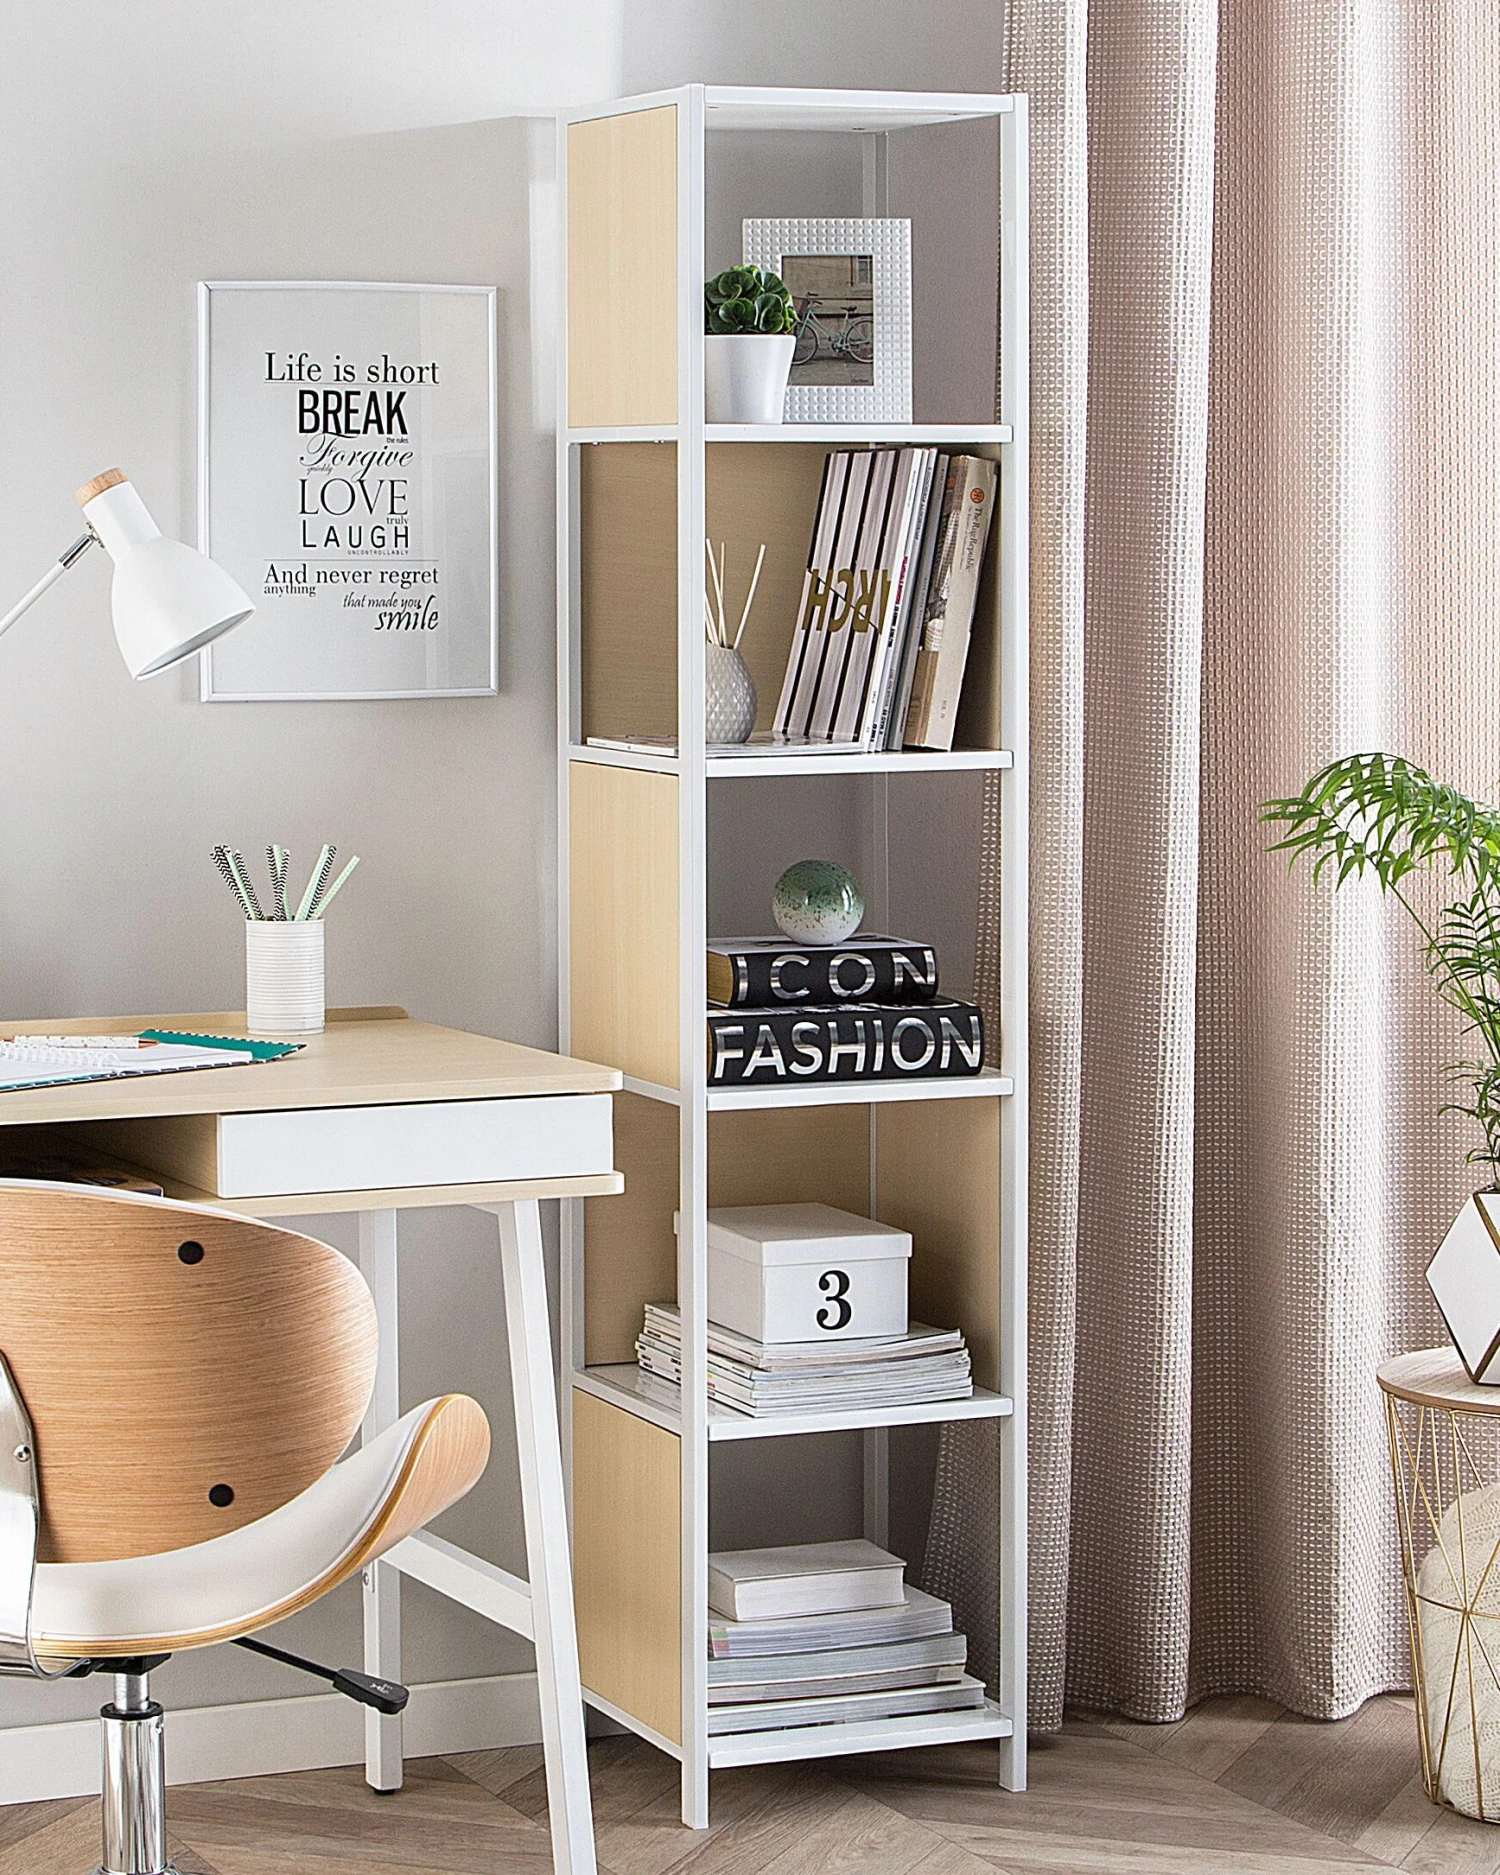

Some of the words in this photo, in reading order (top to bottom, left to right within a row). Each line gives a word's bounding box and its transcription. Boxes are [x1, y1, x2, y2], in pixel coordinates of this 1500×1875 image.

[265, 352, 322, 382] Life
[333, 355, 355, 382] is
[367, 354, 440, 384] short
[299, 389, 408, 435] BREAK
[299, 431, 414, 483] Forgive
[298, 478, 408, 516] LOVE
[302, 519, 409, 548] LAUGH
[263, 581, 317, 598] anything
[264, 563, 308, 584] And
[316, 568, 373, 584] never
[379, 567, 439, 590] regret
[343, 591, 366, 608] that
[367, 591, 398, 608] made
[401, 599, 422, 613] you
[374, 594, 439, 631] smile
[736, 949, 936, 1003] ICON
[713, 1015, 981, 1078] FASHION
[815, 1269, 853, 1331] 3
